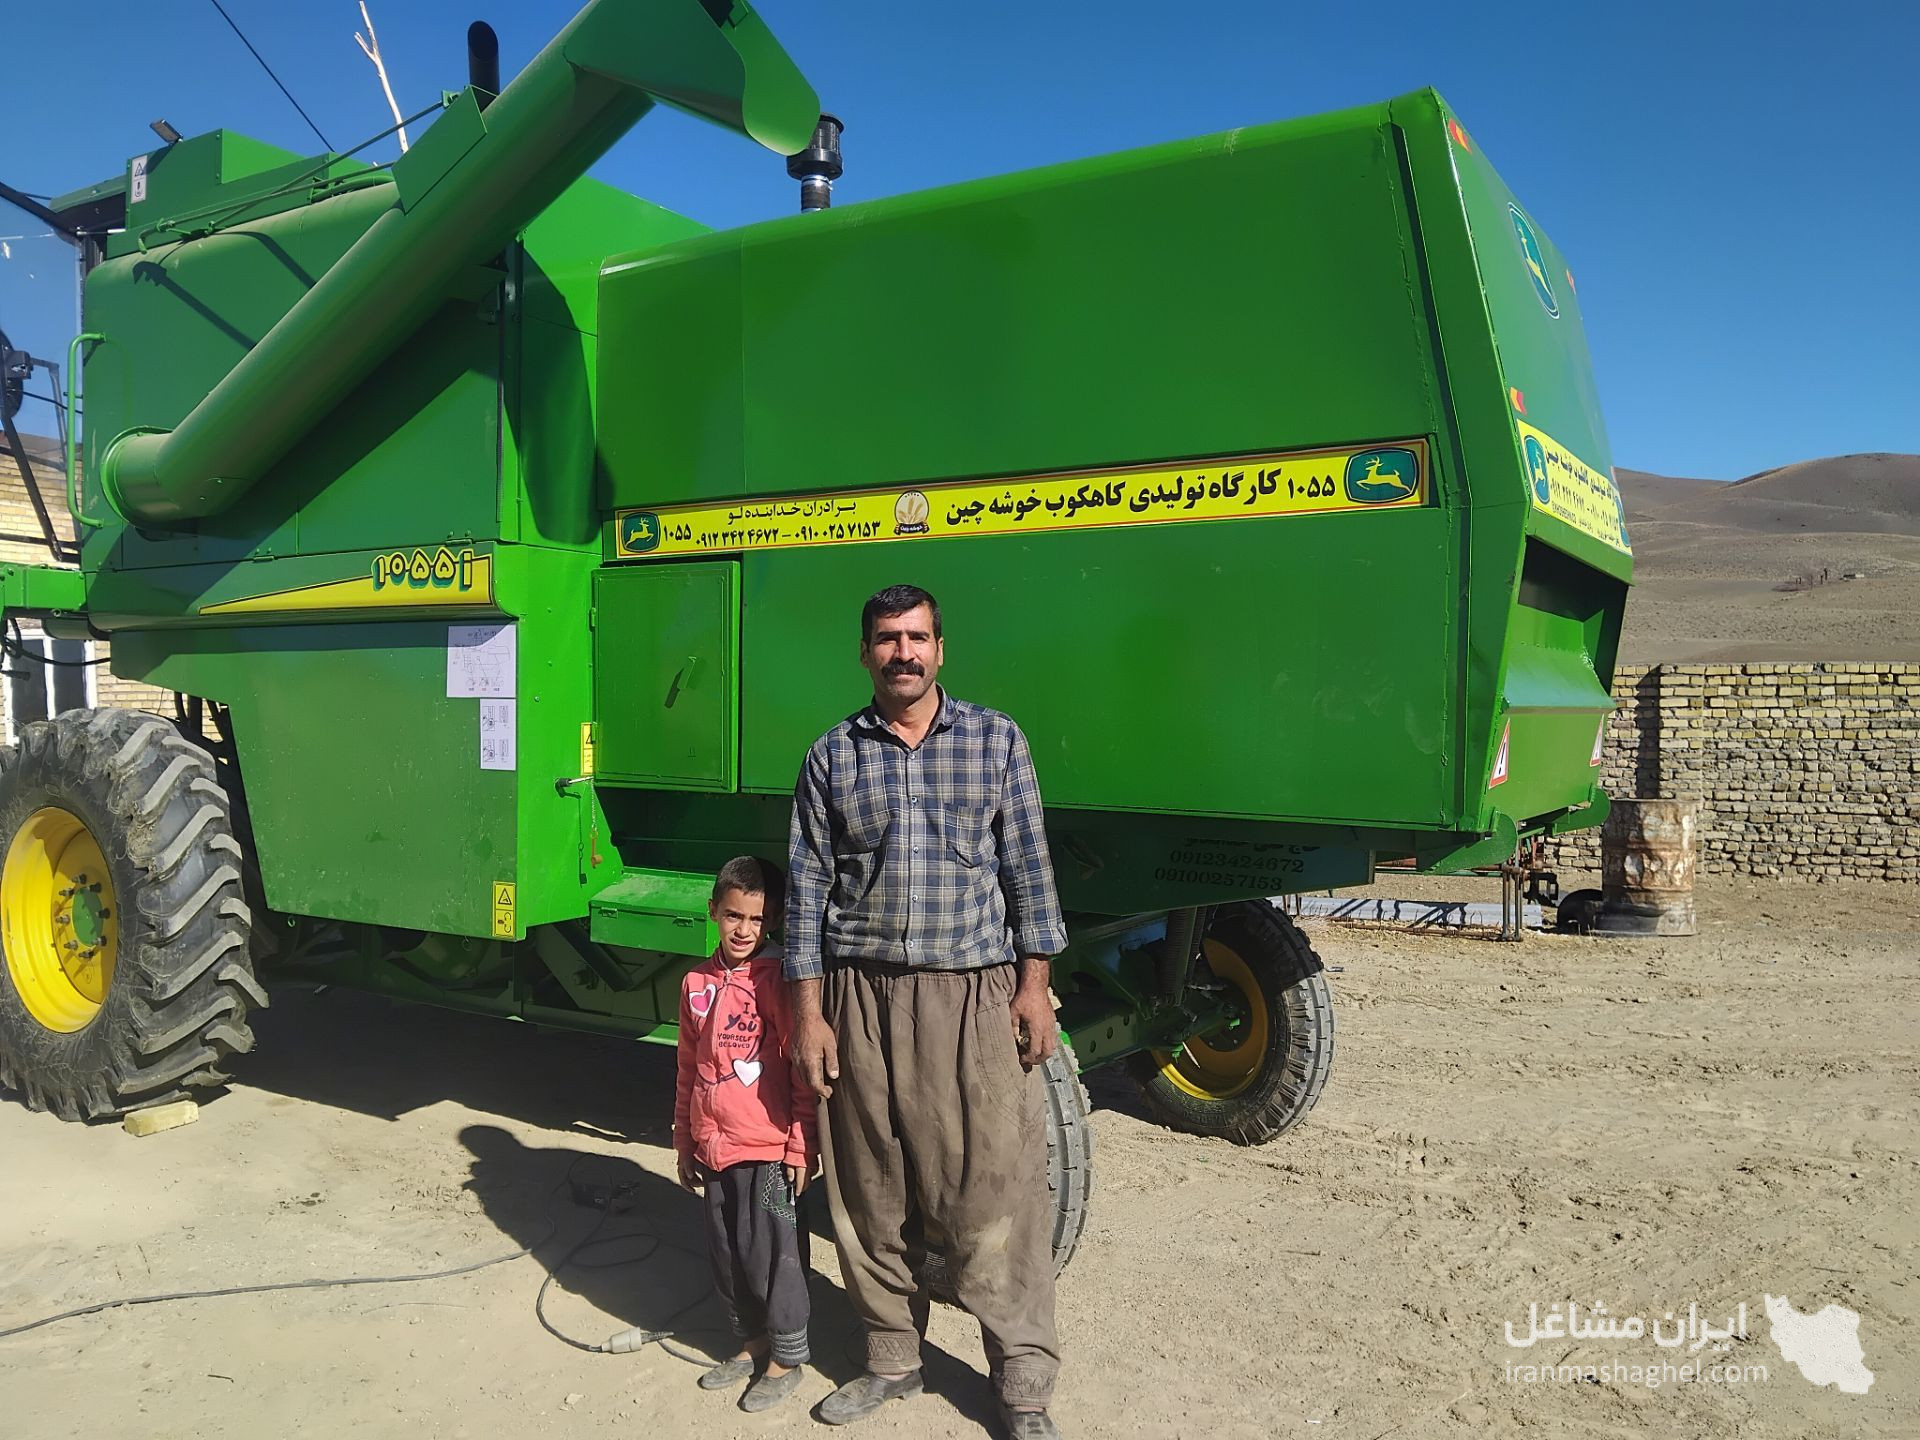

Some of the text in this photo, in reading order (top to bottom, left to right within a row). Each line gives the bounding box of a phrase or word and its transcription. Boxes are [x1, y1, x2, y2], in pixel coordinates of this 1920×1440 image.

[1130, 475, 1206, 512] تولیدی
[1288, 475, 1336, 499] ۱۰۵۵
[803, 499, 856, 517] برادران
[988, 488, 1042, 521] خوشه
[1045, 481, 1126, 518] کاهکوب
[946, 499, 985, 526] چین
[664, 523, 692, 541] ۱۰۵۵
[1170, 850, 1304, 873] 09123424672
[1154, 868, 1283, 891] 09100257153
[742, 1002, 751, 1014] I
[717, 1033, 752, 1042] YOURSELF
